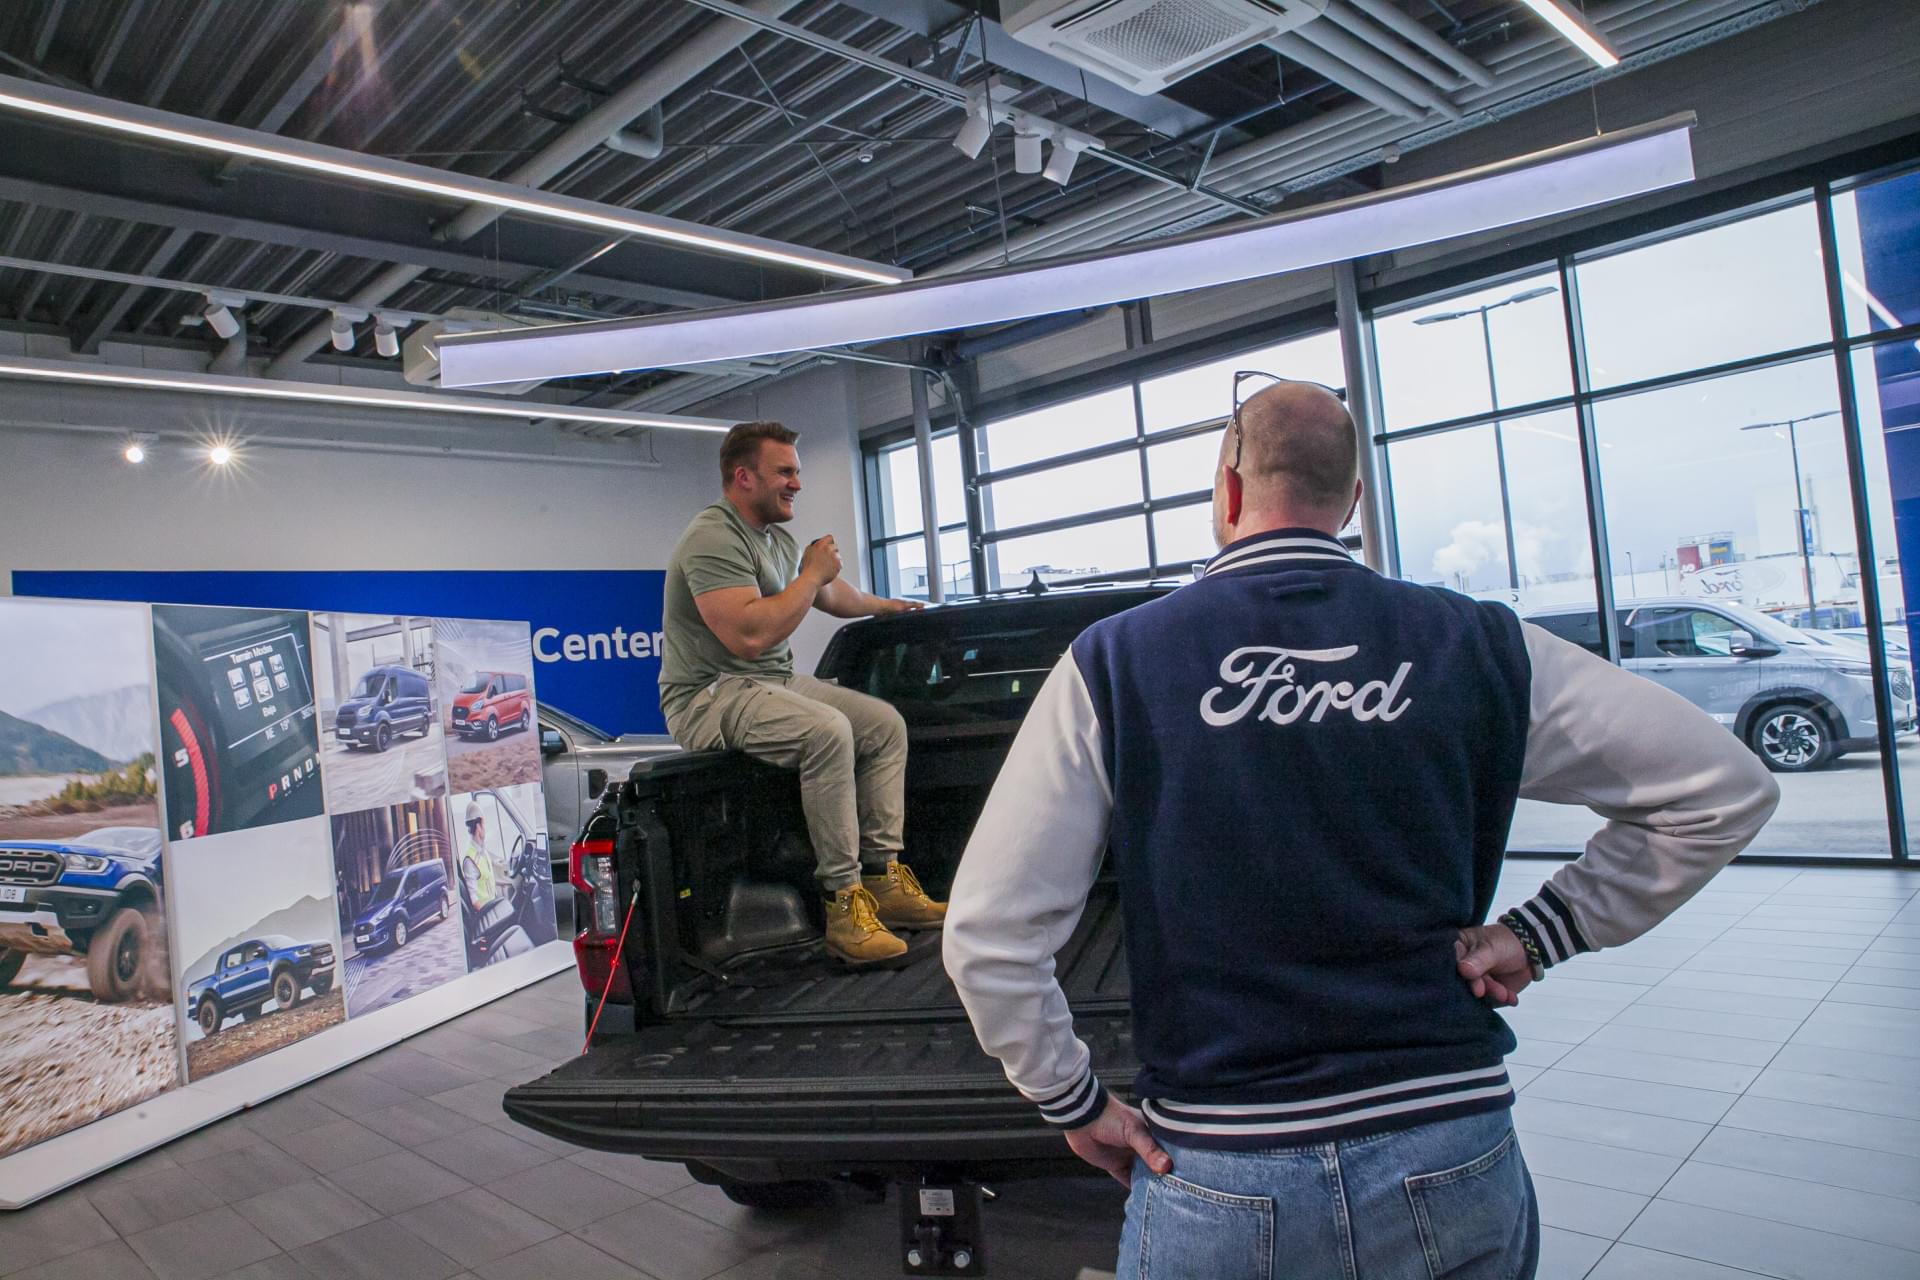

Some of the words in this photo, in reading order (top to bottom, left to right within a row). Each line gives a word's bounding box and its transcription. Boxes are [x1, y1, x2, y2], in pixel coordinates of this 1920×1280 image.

[532, 625, 664, 664] Center
[1200, 645, 1413, 727] Ford
[174, 747, 189, 768] 5
